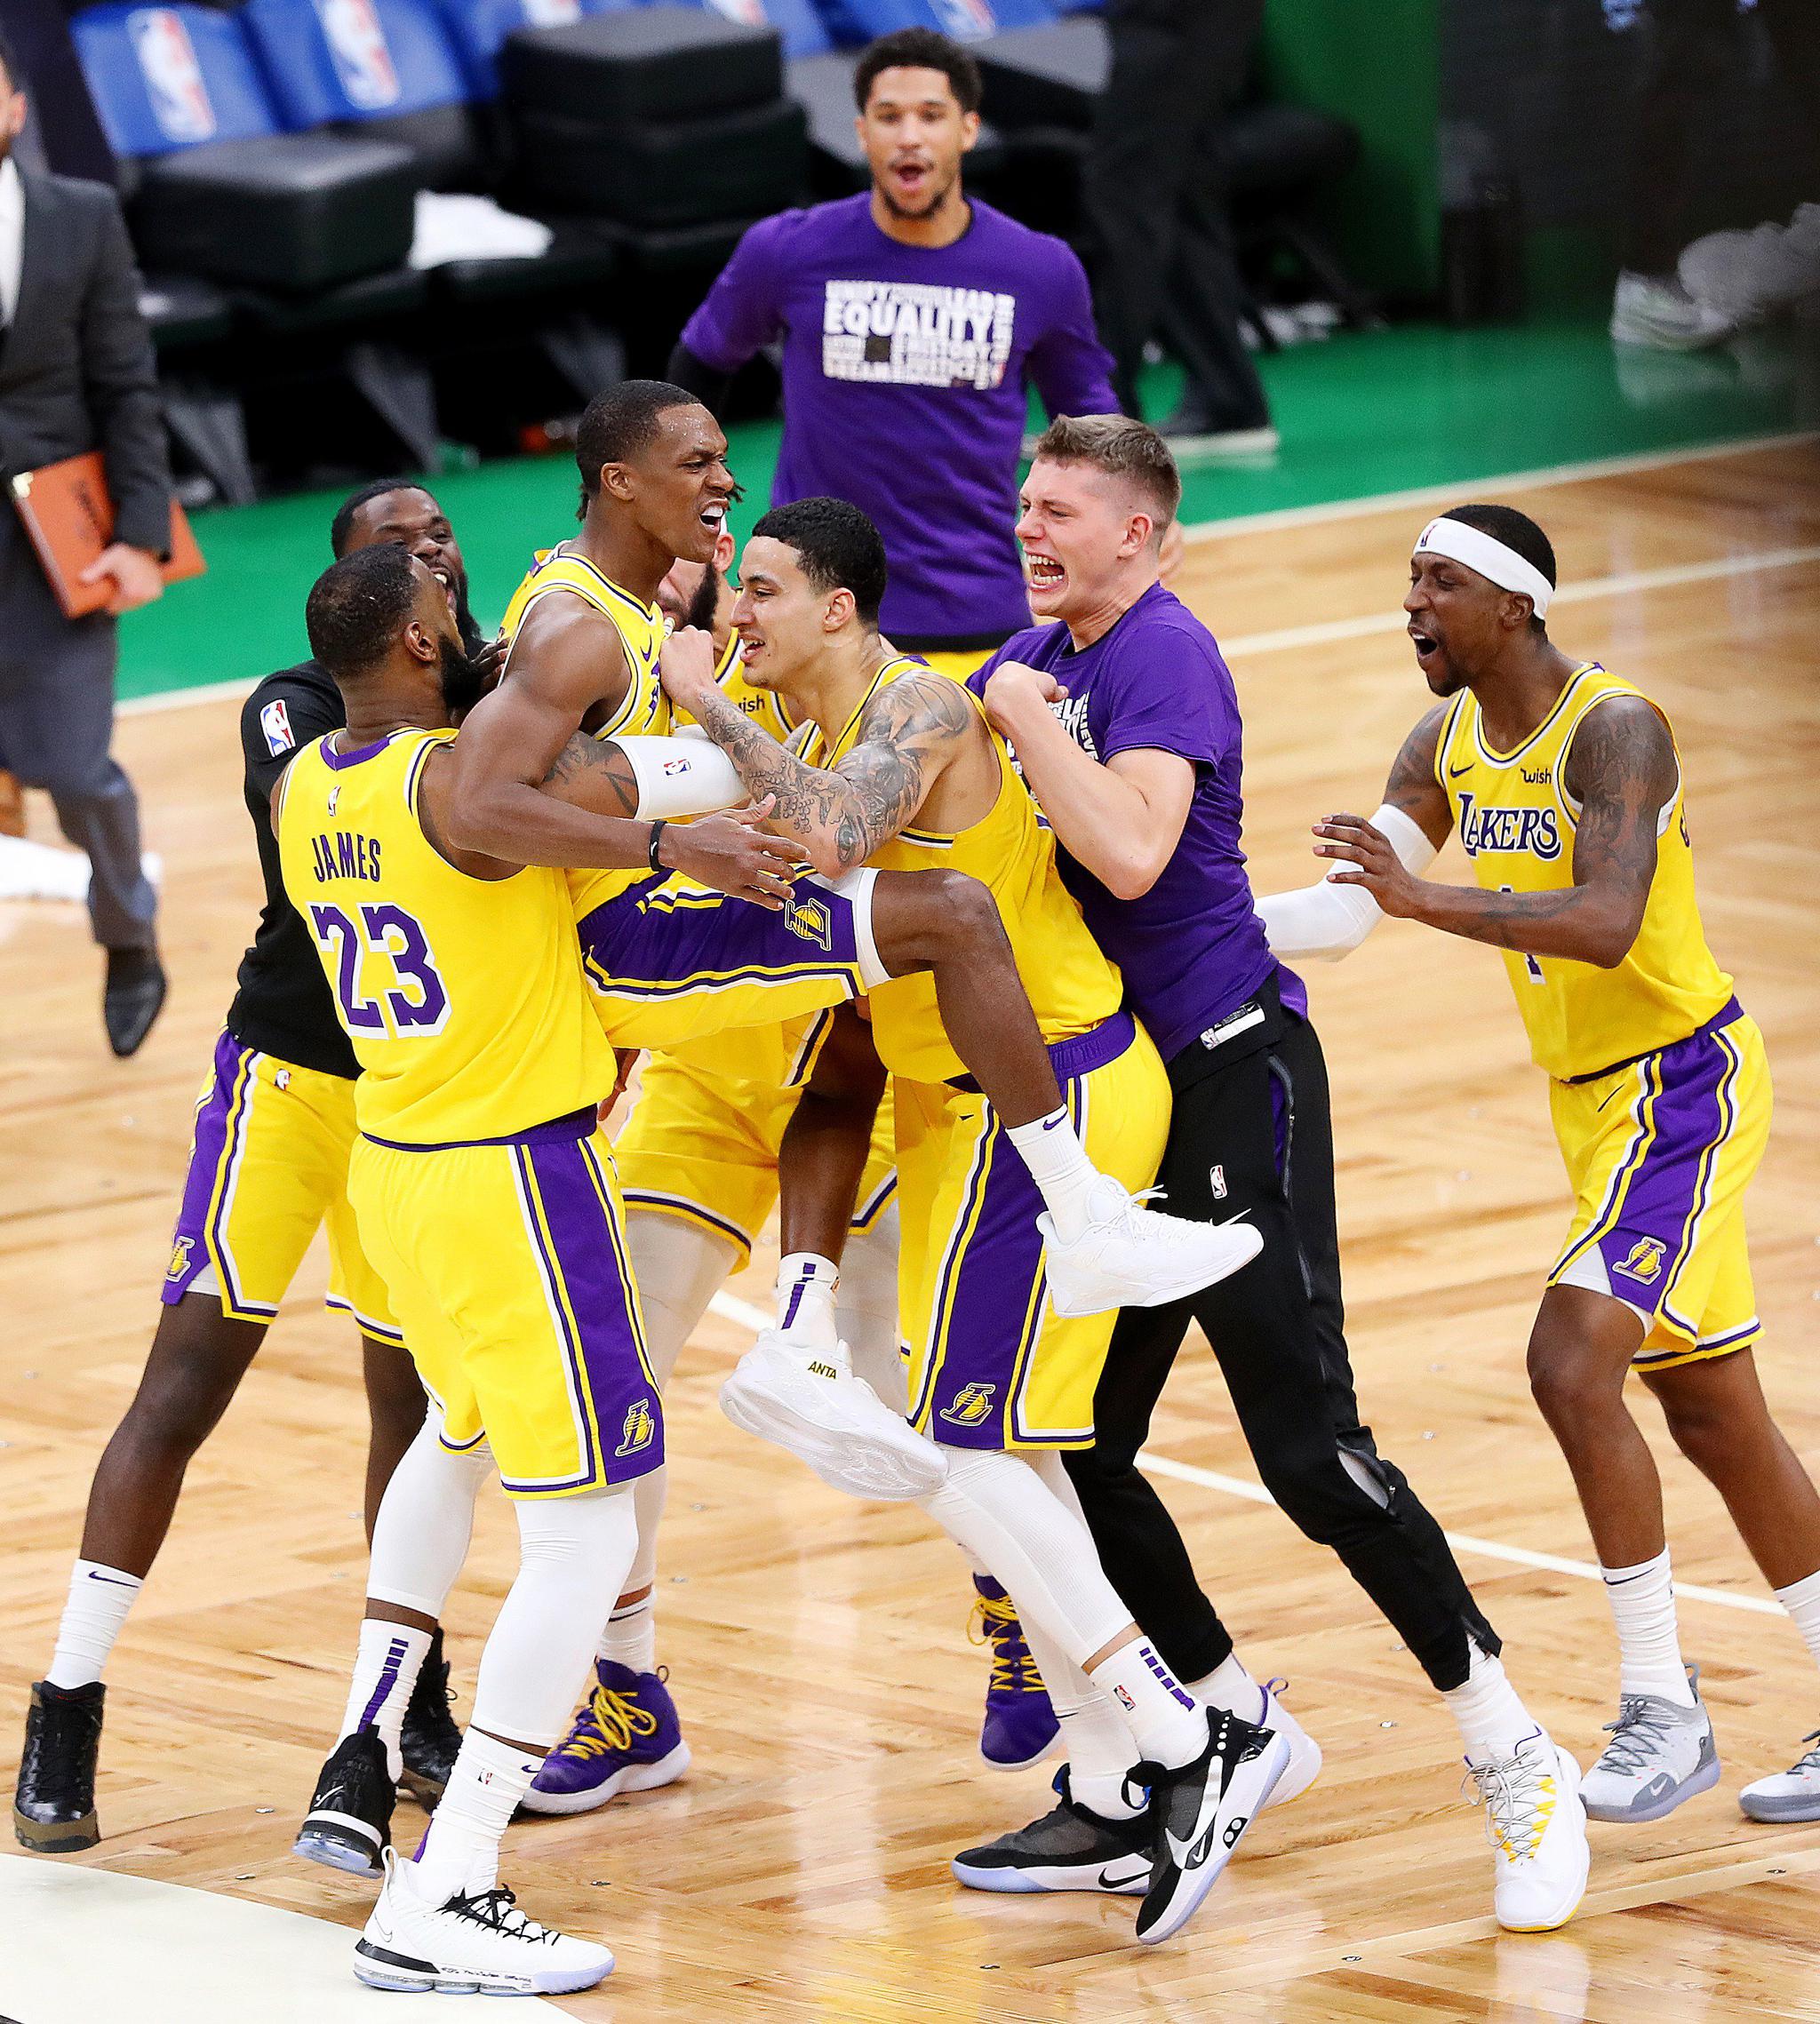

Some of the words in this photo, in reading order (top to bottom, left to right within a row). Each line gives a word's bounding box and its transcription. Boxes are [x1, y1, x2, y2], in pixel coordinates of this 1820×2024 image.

[824, 299, 994, 344] EQUALITY
[1521, 767, 1553, 785] wish
[1457, 791, 1561, 862] LAKERS
[311, 833, 381, 882] JAMES
[307, 902, 452, 1040] 23
[807, 1360, 838, 1380] ANTA
